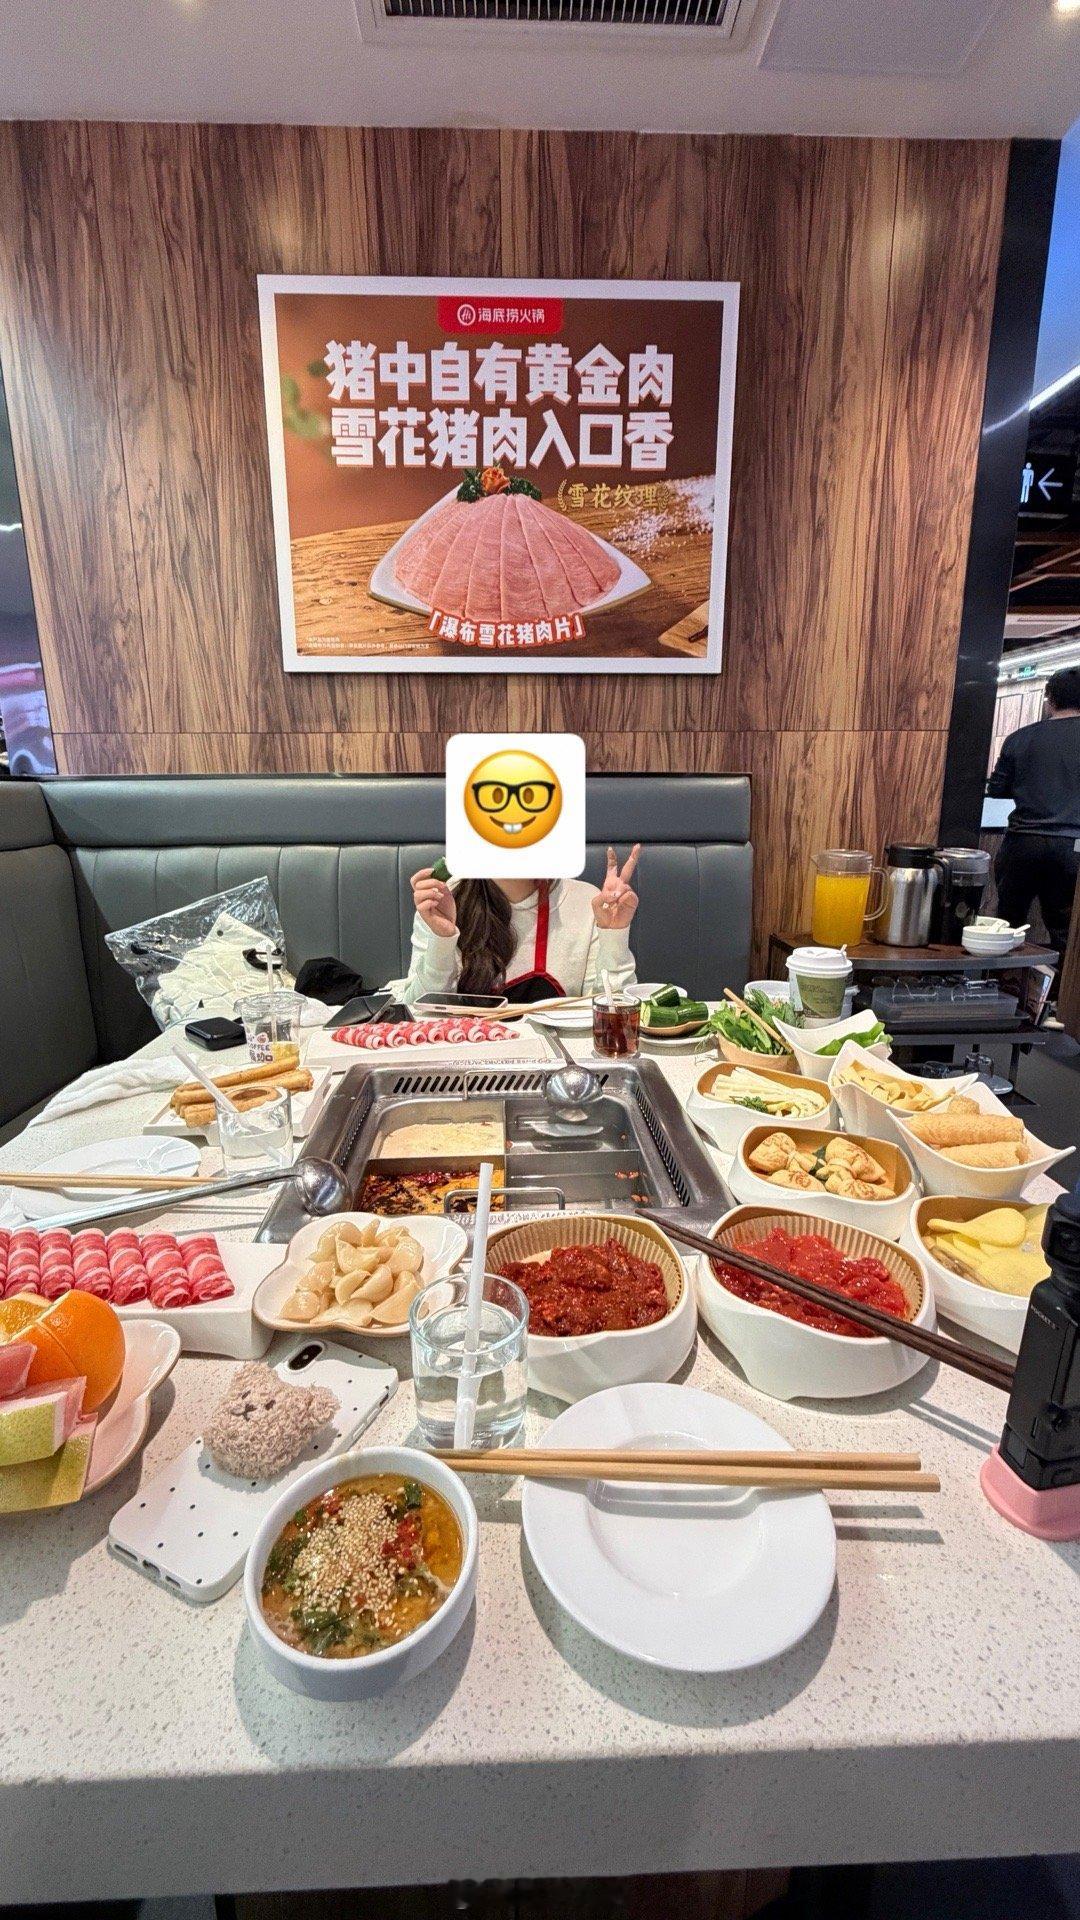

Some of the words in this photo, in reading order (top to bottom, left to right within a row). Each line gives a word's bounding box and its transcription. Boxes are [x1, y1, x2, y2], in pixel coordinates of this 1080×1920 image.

[477, 307, 545, 324] 海底捞火锅
[323, 339, 674, 407] 猪中自有黄金肉
[330, 406, 675, 471] 雪花猪肉入口香
[567, 482, 659, 509] 雪花纹理
